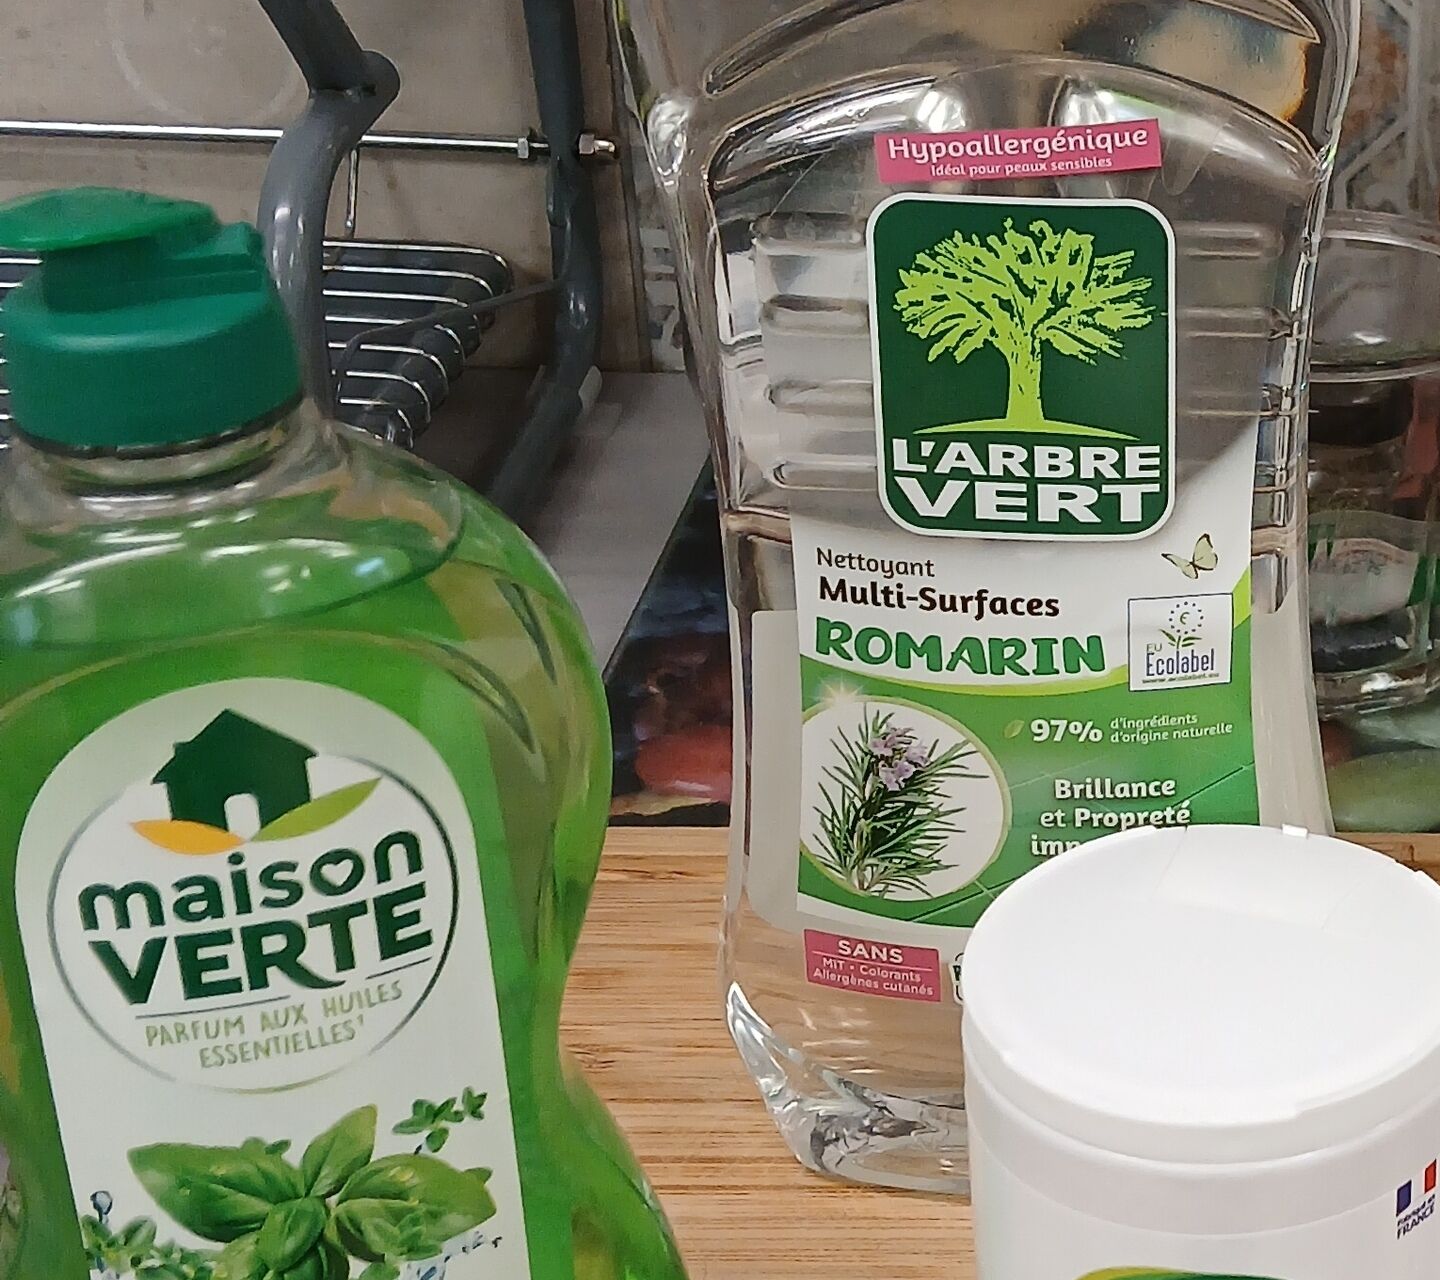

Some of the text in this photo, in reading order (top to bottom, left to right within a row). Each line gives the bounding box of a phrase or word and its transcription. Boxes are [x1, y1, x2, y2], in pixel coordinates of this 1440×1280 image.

[887, 127, 1149, 166] Hypoallergénique
[930, 155, 1113, 180] Idéal pour peaux sensibles
[892, 438, 1161, 479] L'ARBRE
[893, 476, 1160, 523] VERT
[816, 547, 936, 579] Nettoyant
[818, 576, 1061, 621] Multi-Surfaces
[814, 616, 1106, 677] ROMARIN
[1146, 648, 1214, 676] Ecolabel
[1030, 718, 1103, 743] 97%
[1110, 713, 1198, 732] d'ingrédients
[1110, 722, 1233, 745] d'origine naturelle
[1054, 777, 1176, 800] Brillance
[1040, 799, 1191, 831] et Propreté
[77, 829, 424, 931] maison
[87, 881, 433, 1005] VERTE
[838, 939, 903, 964] SANS
[813, 967, 934, 997] Allergènes cutanés
[823, 957, 921, 983] MIT Colorants
[145, 980, 402, 1048] PARFUM AUX HUILES
